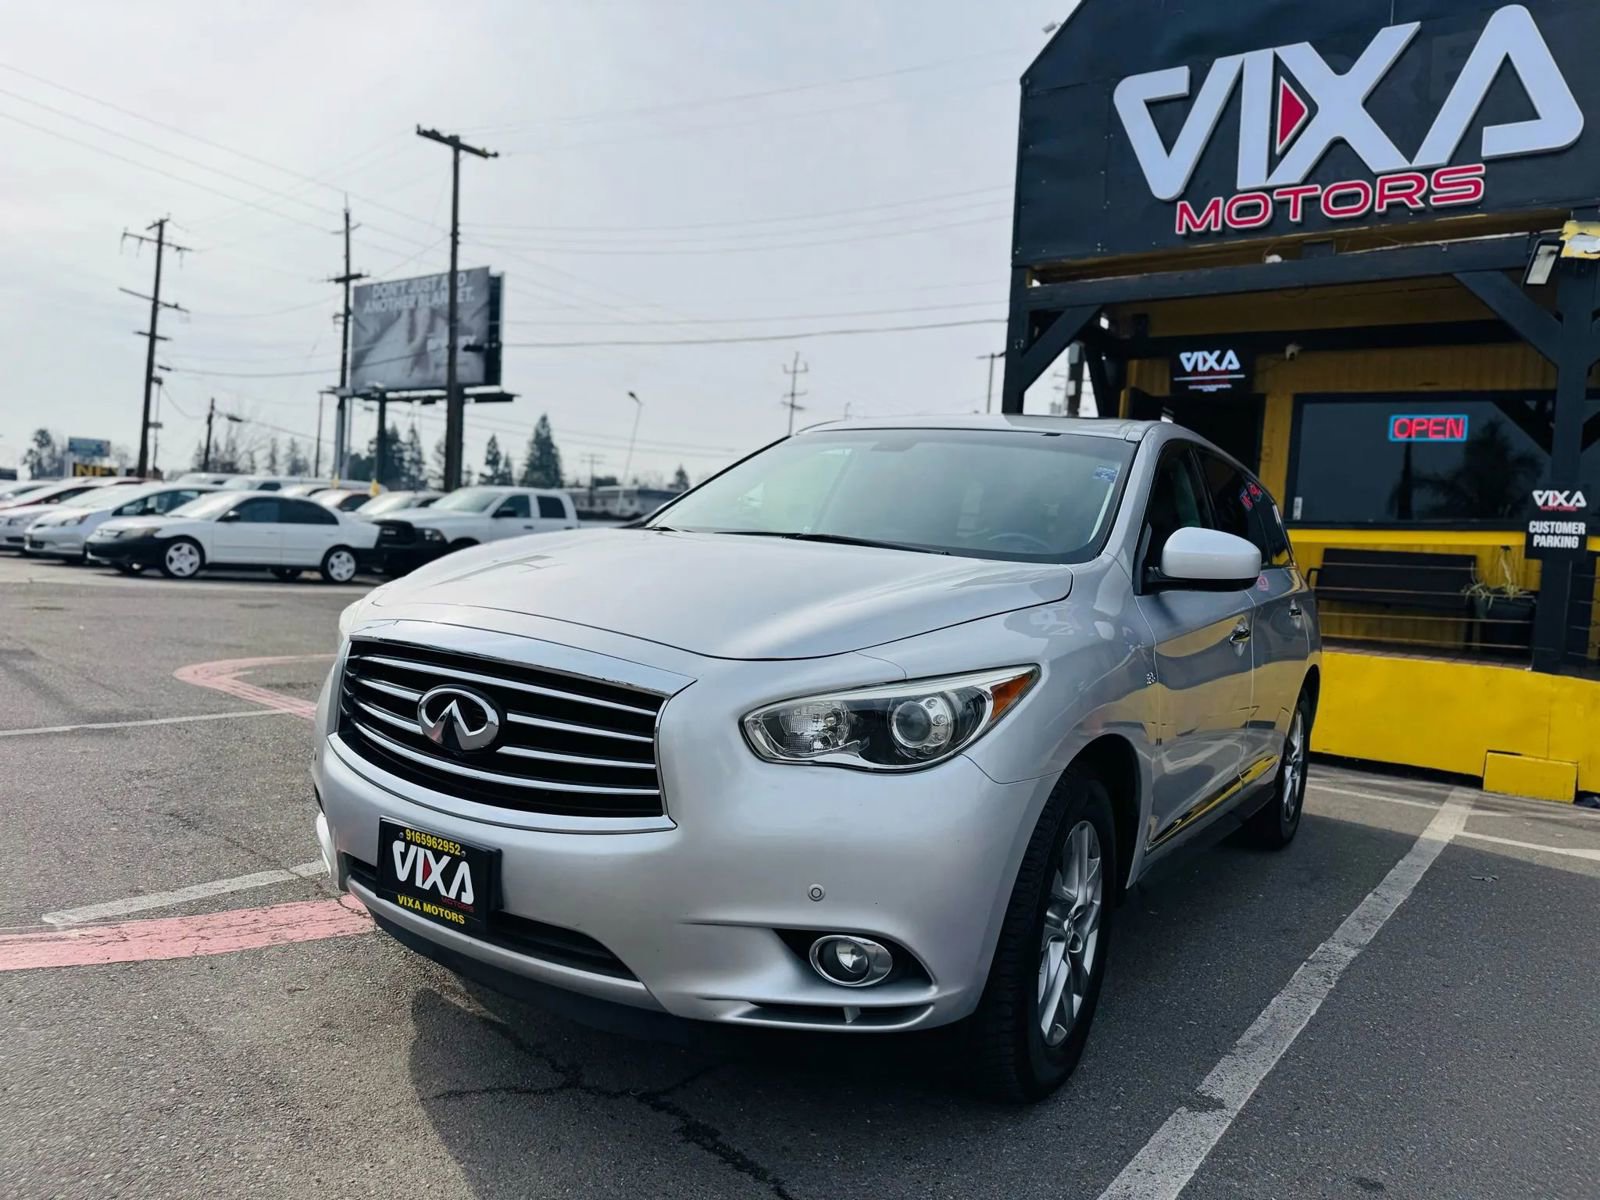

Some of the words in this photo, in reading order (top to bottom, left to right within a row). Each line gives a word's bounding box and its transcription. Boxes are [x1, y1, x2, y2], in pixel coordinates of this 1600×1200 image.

[1113, 4, 1584, 199] VIXA
[1175, 164, 1486, 235] MOTORS
[440, 272, 468, 290] AD
[1179, 350, 1241, 372] VIXA
[1394, 417, 1464, 439] OPEN
[1532, 490, 1587, 508] VIXA
[1529, 520, 1586, 535] CUSTOMER
[1533, 534, 1579, 549] PARKING
[405, 829, 461, 856] 9165962952
[392, 840, 475, 905] VIXA
[397, 894, 421, 911] VIXA
[423, 902, 465, 925] MOTORS
